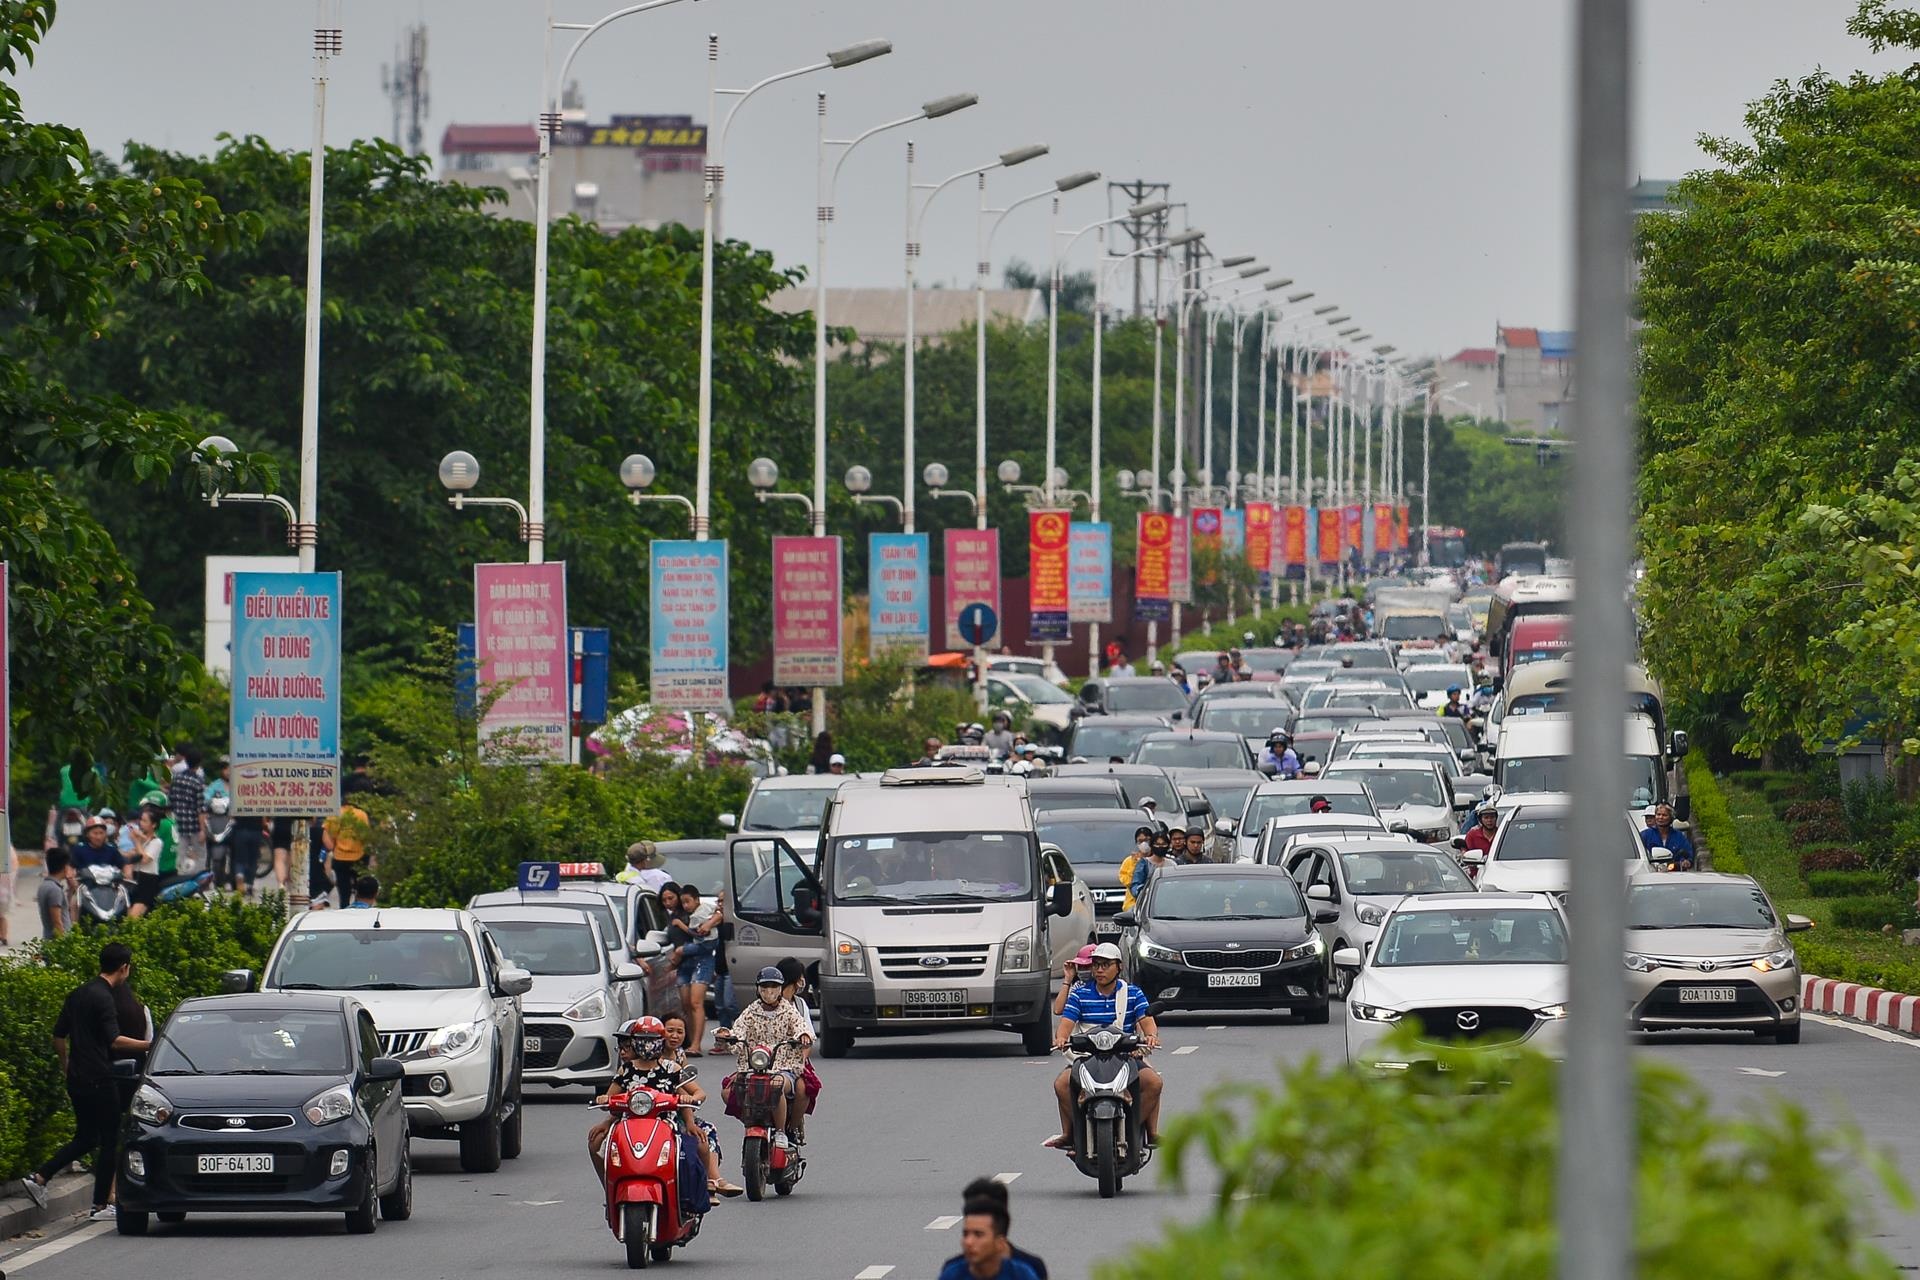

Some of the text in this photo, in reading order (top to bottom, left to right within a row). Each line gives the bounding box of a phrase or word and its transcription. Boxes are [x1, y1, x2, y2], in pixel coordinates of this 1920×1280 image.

[314, 597, 329, 618] XE
[264, 632, 311, 658] ĐI ĐÚNG
[262, 766, 333, 778] TAXI LONG BIÊN
[574, 863, 598, 874] 123
[908, 992, 961, 1003] 89B-003.16
[1682, 990, 1734, 1001] 20A-119.19
[200, 1157, 271, 1172] 30F-641.30
